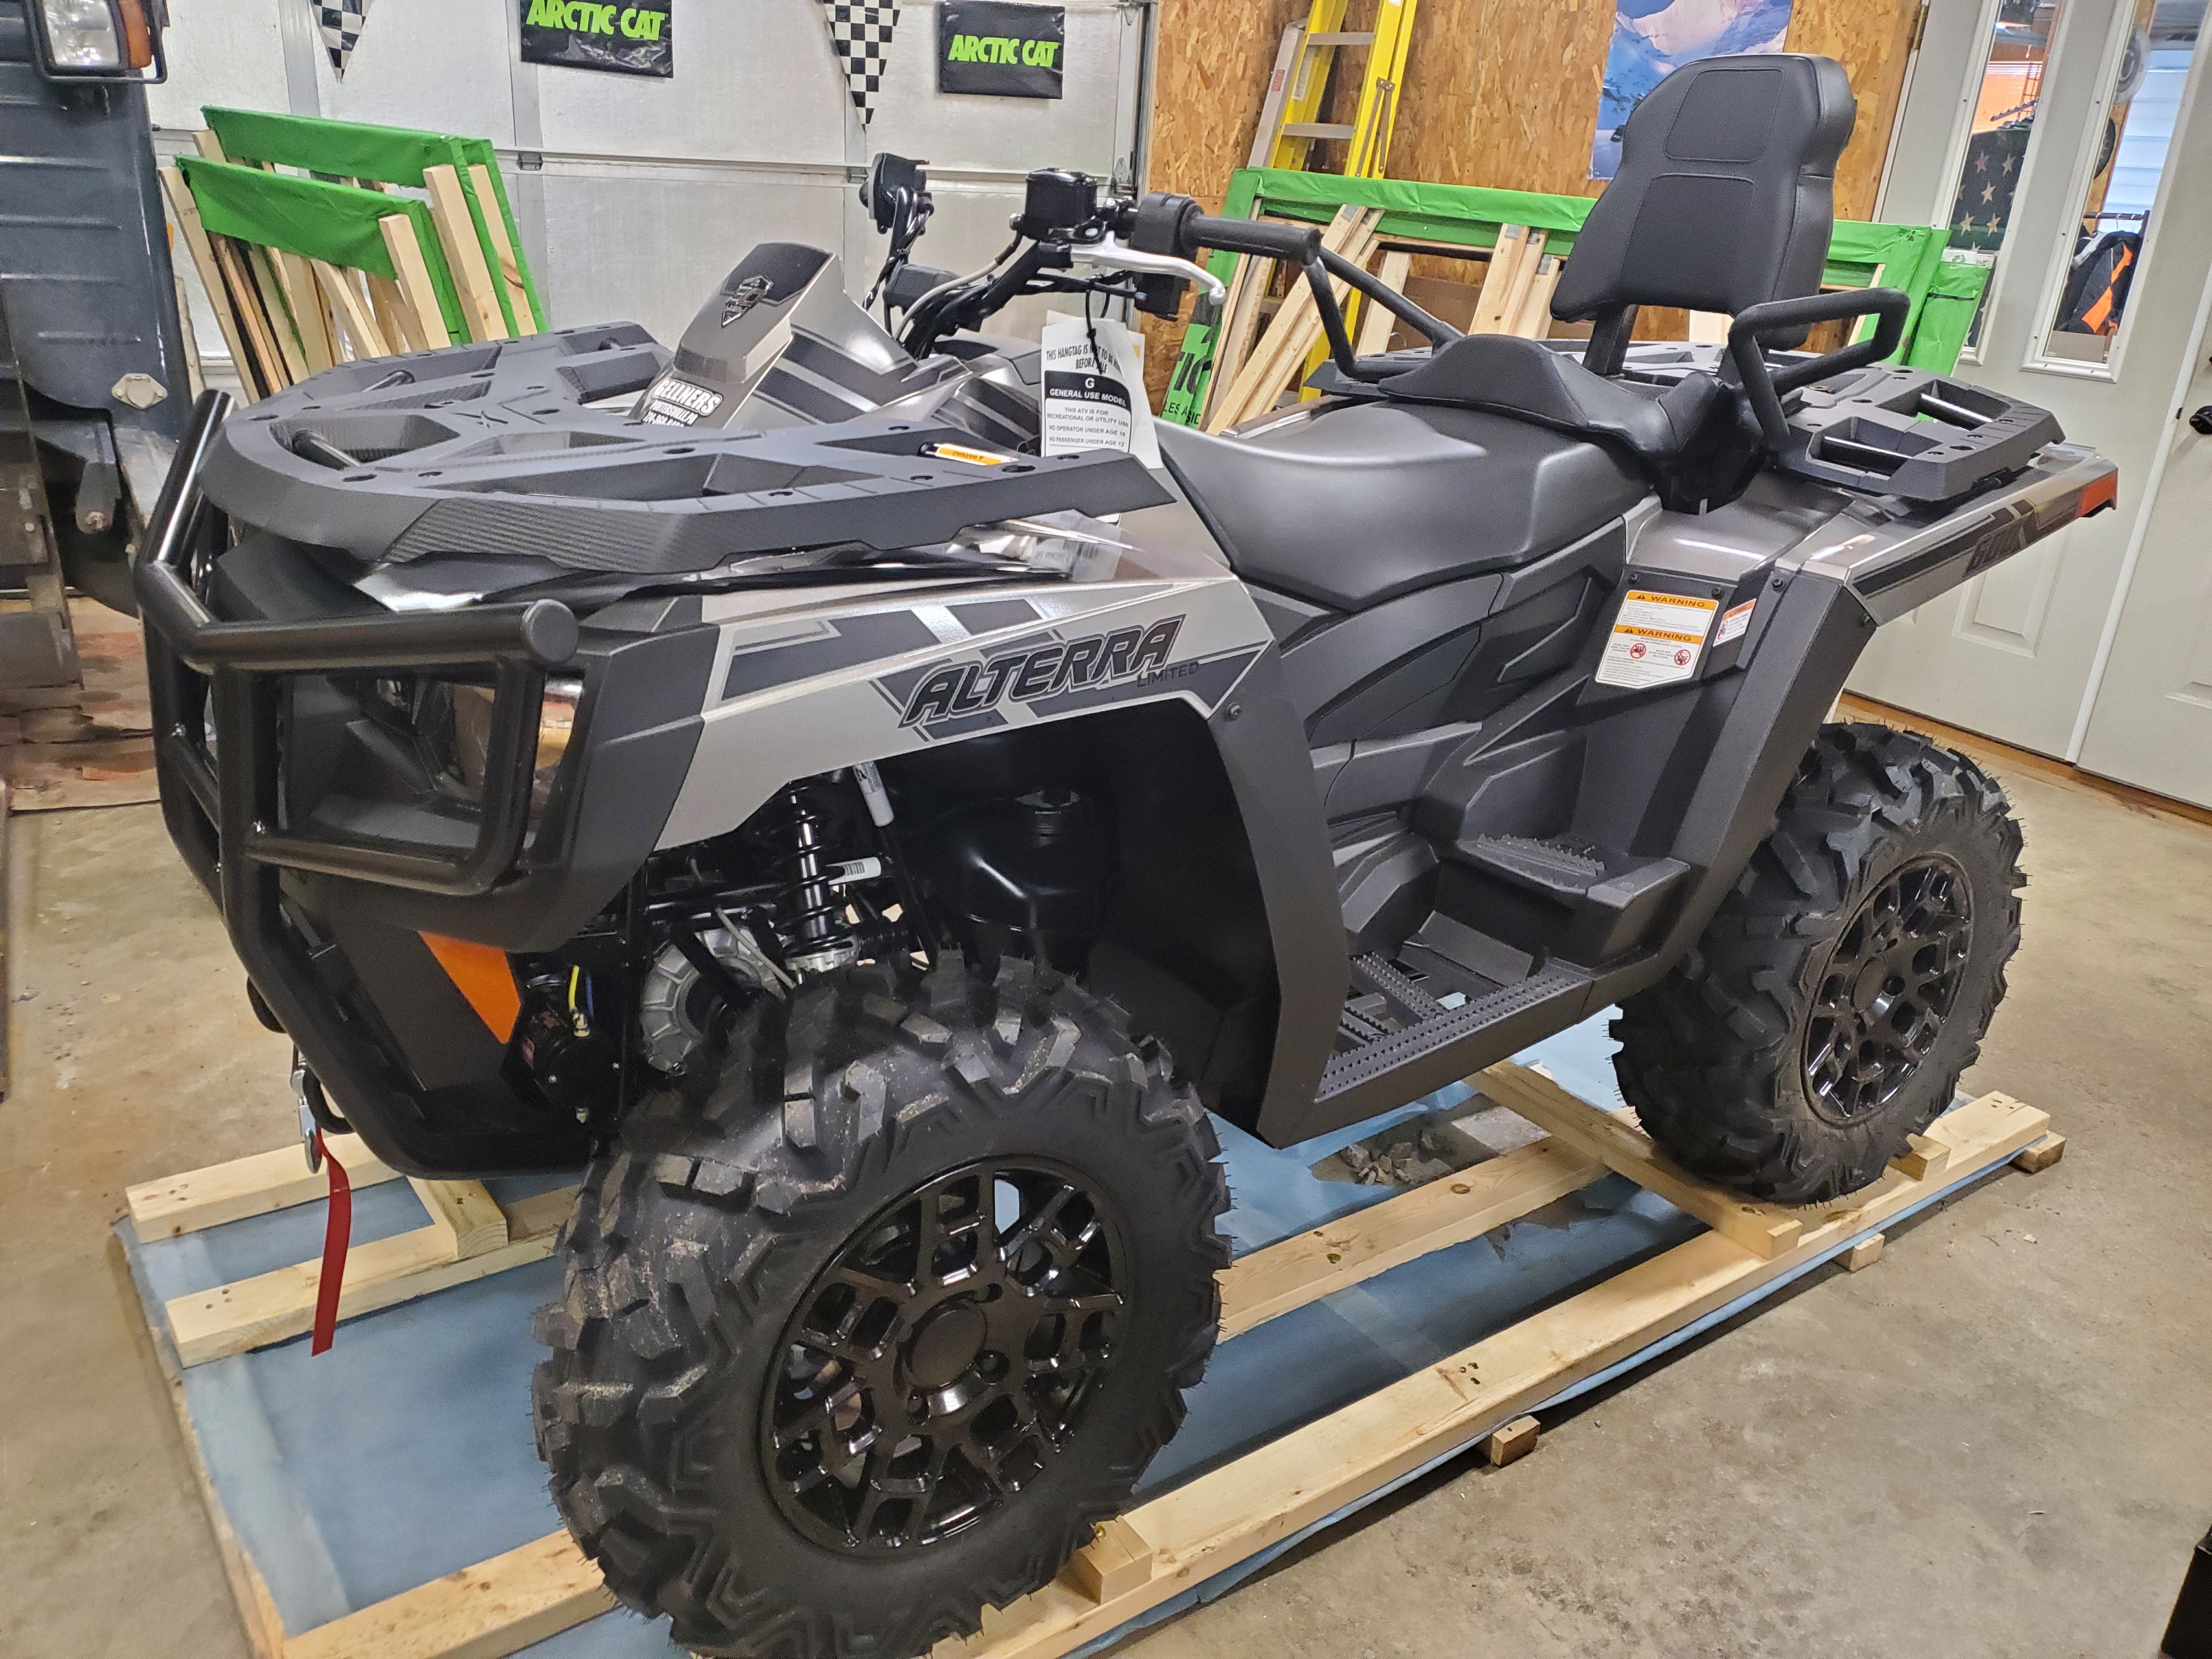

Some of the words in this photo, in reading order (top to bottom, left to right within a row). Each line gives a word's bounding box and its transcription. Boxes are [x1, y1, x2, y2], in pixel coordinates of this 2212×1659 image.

[526, 0, 617, 35] ARCTIC
[620, 8, 665, 41] CAT
[947, 35, 1020, 64] ARCTIC
[1022, 40, 1059, 67] CAT
[1046, 349, 1056, 361] THIS
[1058, 345, 1082, 358] HANGTAG
[1083, 344, 1088, 354] IS
[1101, 349, 1108, 360] TO
[1085, 377, 1095, 388] G
[653, 378, 721, 414] GELLNERS
[1049, 388, 1083, 398] GENERAL
[1084, 391, 1100, 399] USE
[1102, 393, 1127, 407] MODEL
[1047, 413, 1084, 421] RECREATIONAL
[1095, 416, 1117, 425] UTILITY
[1651, 595, 1705, 607] WARNING
[1638, 628, 1691, 641] WARNING
[898, 614, 1187, 729] ALTERRA
[1137, 661, 1199, 688] LIMITED
